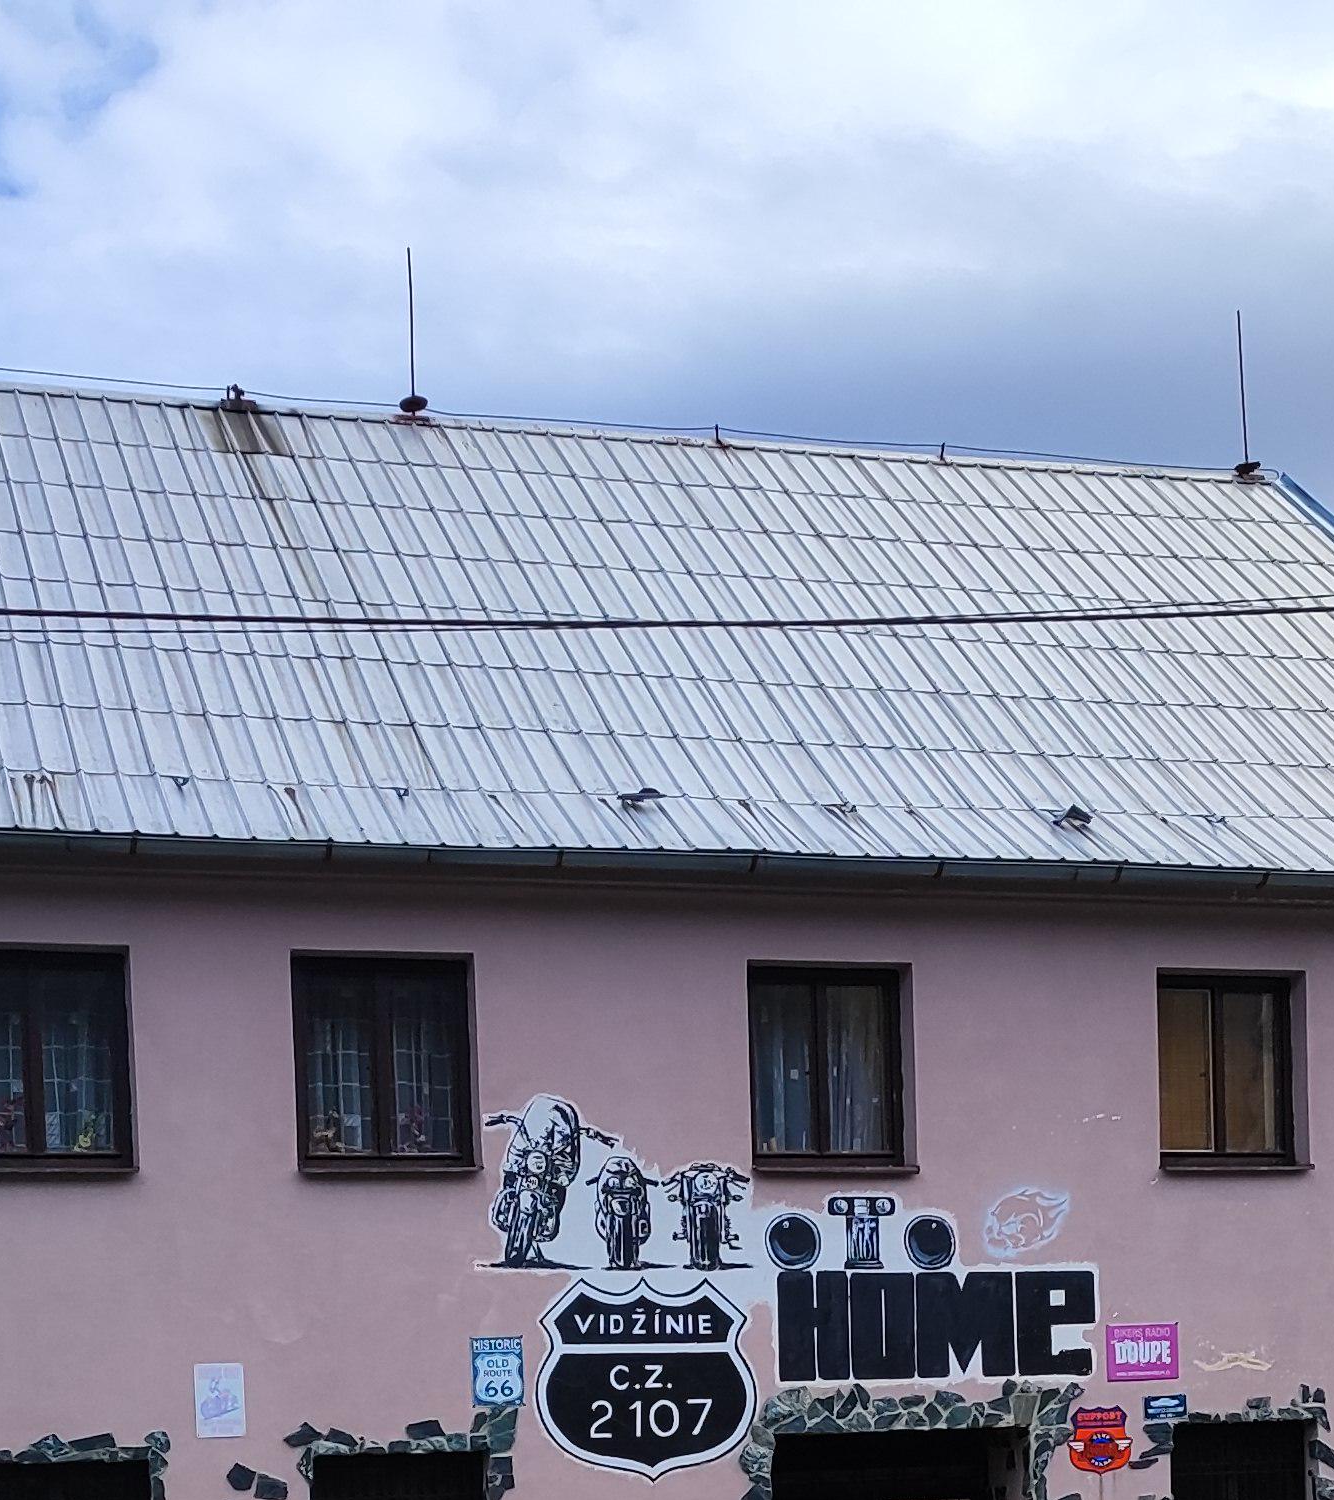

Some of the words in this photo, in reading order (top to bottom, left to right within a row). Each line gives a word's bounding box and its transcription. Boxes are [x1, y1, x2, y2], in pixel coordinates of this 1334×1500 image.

[573, 1307, 714, 1336] VIDŽÍNIE
[777, 1270, 1097, 1382] HOME
[472, 1339, 521, 1351] HISTORIC
[486, 1358, 509, 1369] OLD
[483, 1369, 513, 1378] ROUTE
[484, 1379, 514, 1398] 66
[1076, 1410, 1123, 1422] SUPPORT
